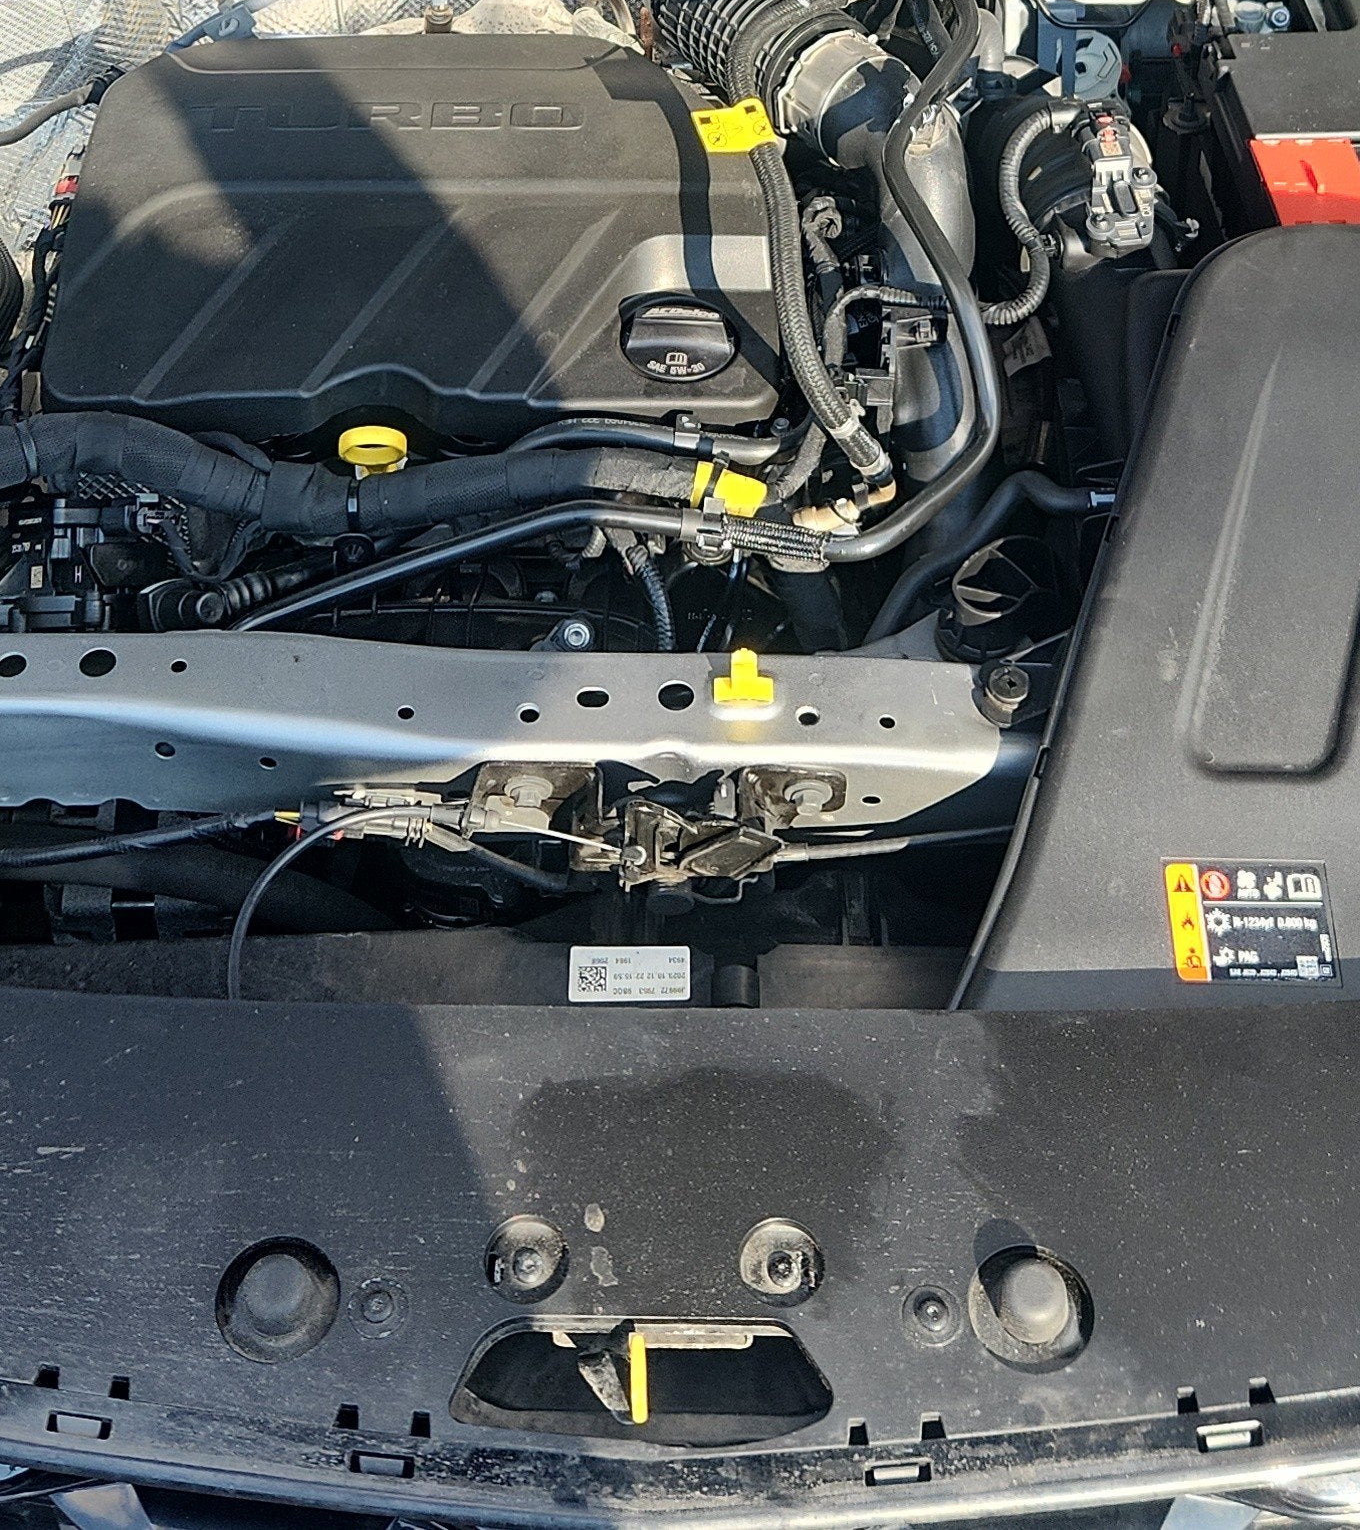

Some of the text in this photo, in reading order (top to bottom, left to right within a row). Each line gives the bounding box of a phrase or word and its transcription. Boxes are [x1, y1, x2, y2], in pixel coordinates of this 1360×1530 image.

[190, 102, 584, 131] TURBO
[646, 360, 706, 375] SAE 5W-30
